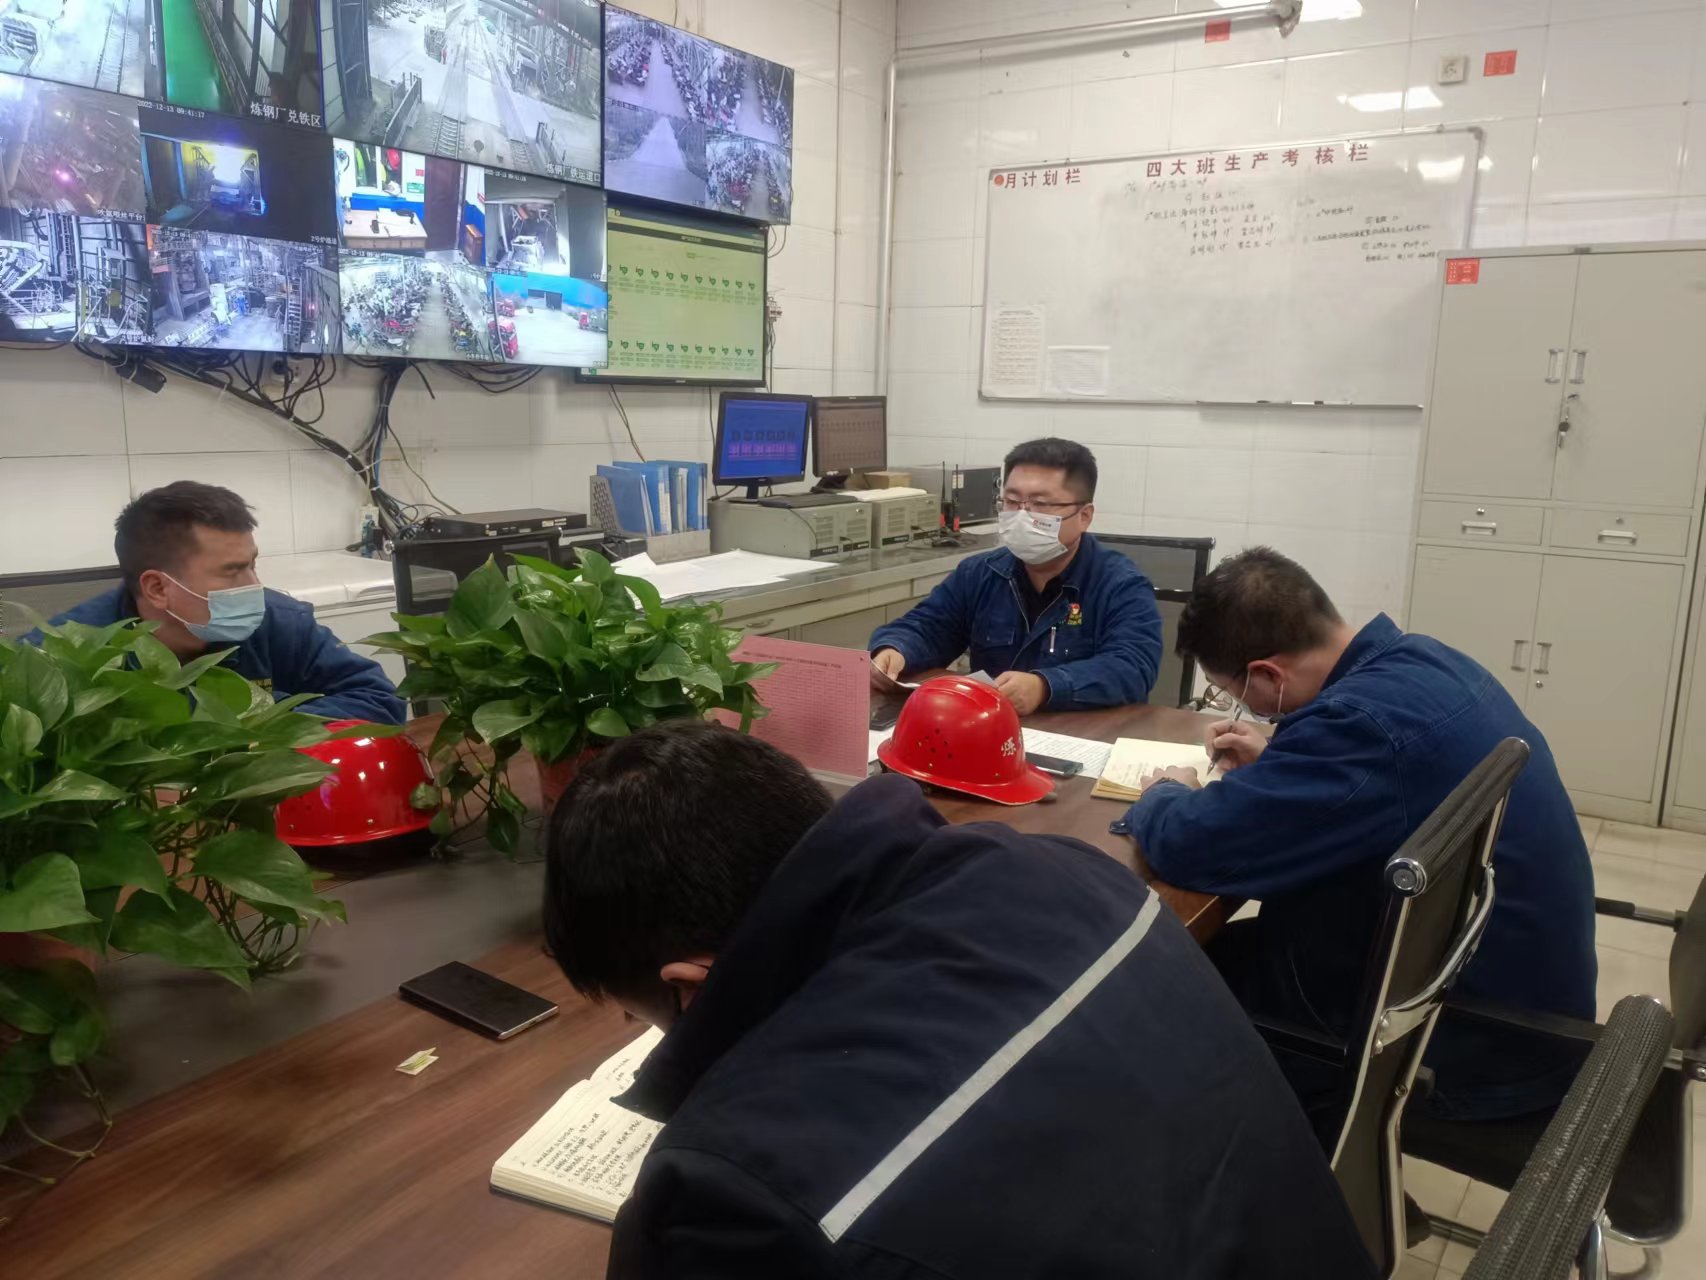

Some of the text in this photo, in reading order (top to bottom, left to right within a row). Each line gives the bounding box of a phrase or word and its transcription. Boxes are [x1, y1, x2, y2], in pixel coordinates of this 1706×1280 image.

[137, 99, 174, 113] 2022-12-13
[250, 100, 322, 128] 炼钢厂兑铁区
[1146, 143, 1369, 178] 四大班生产考核栏
[1004, 168, 1080, 189] 月计划栏
